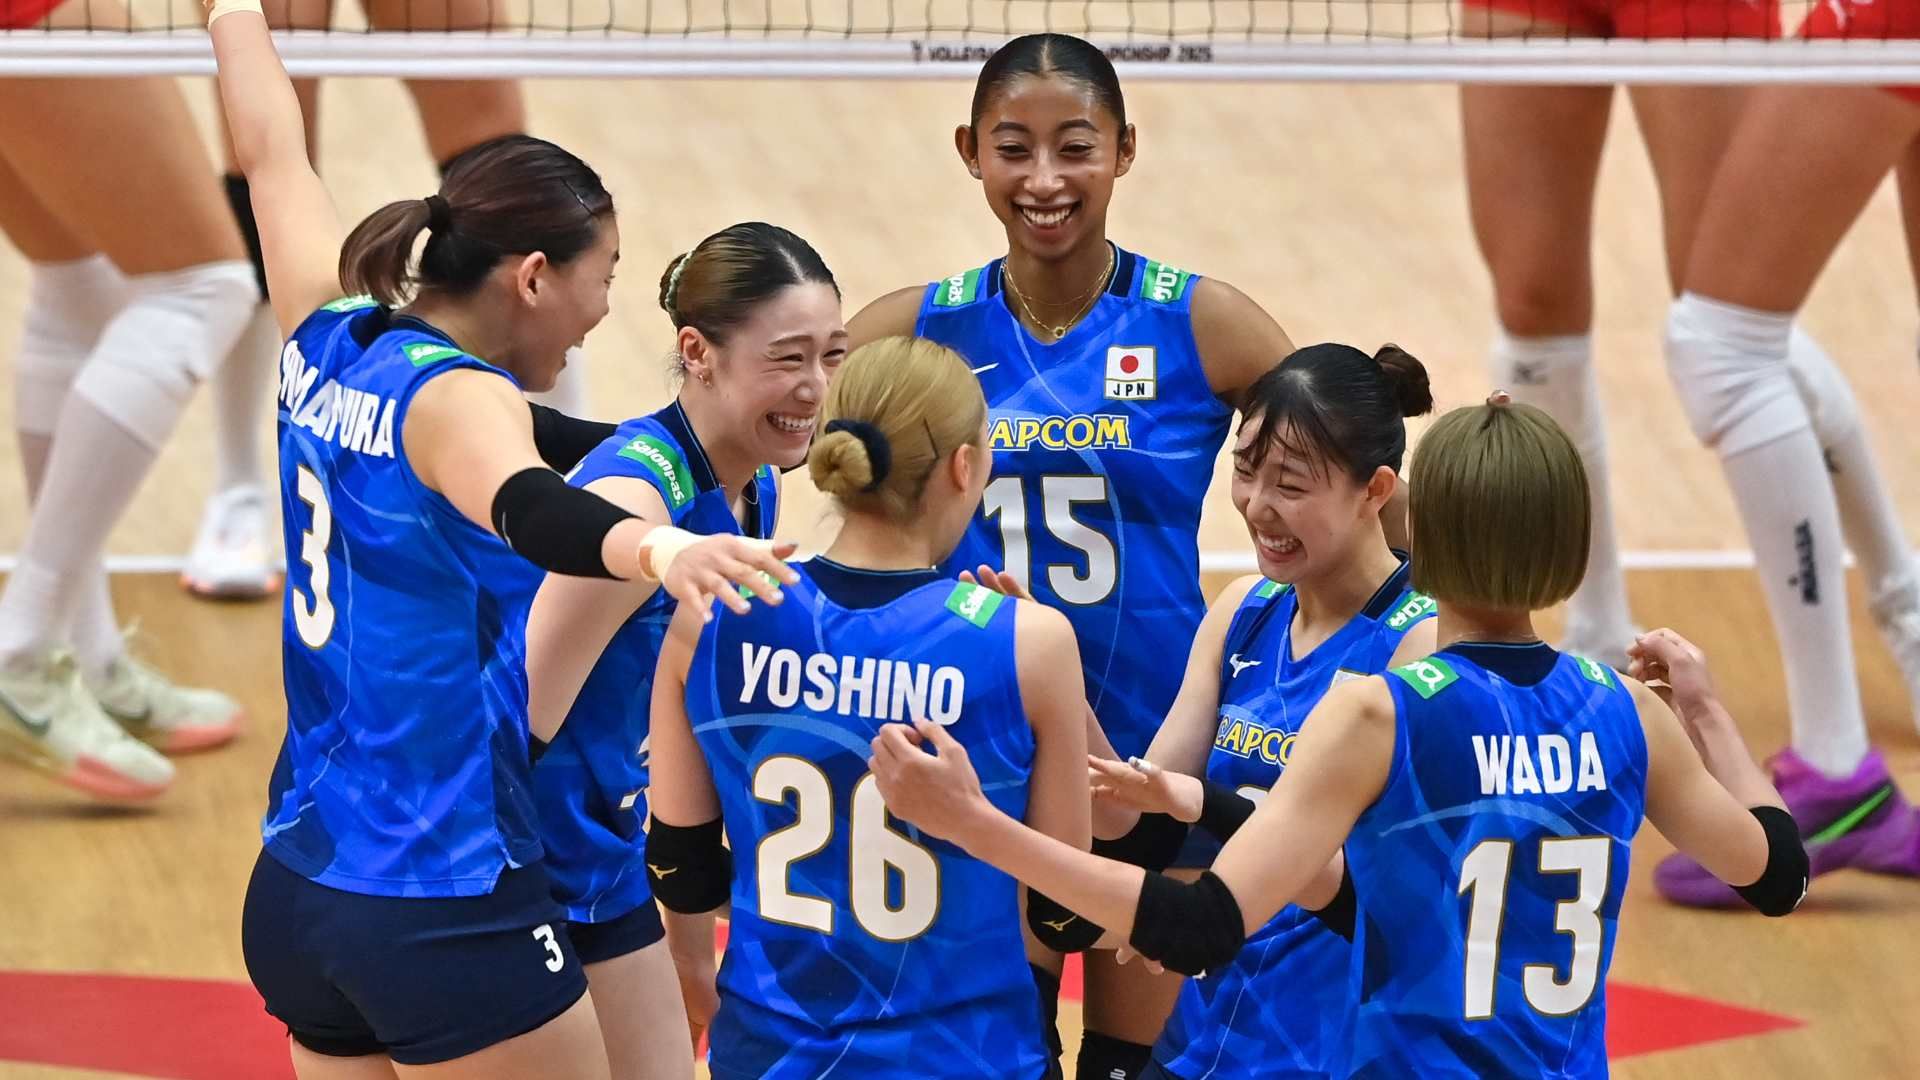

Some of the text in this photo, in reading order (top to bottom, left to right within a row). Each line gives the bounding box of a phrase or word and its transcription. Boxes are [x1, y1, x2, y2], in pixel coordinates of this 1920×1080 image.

[1112, 382, 1146, 397] JPN
[986, 414, 1132, 451] APCOM
[627, 439, 685, 502] Salonpas
[292, 463, 336, 649] 3
[981, 474, 1119, 607] 15
[739, 641, 966, 727] YOSHINO
[1471, 731, 1608, 796] WADA
[752, 753, 942, 943] 26
[532, 922, 565, 973] 3
[1457, 835, 1614, 1022] 13
